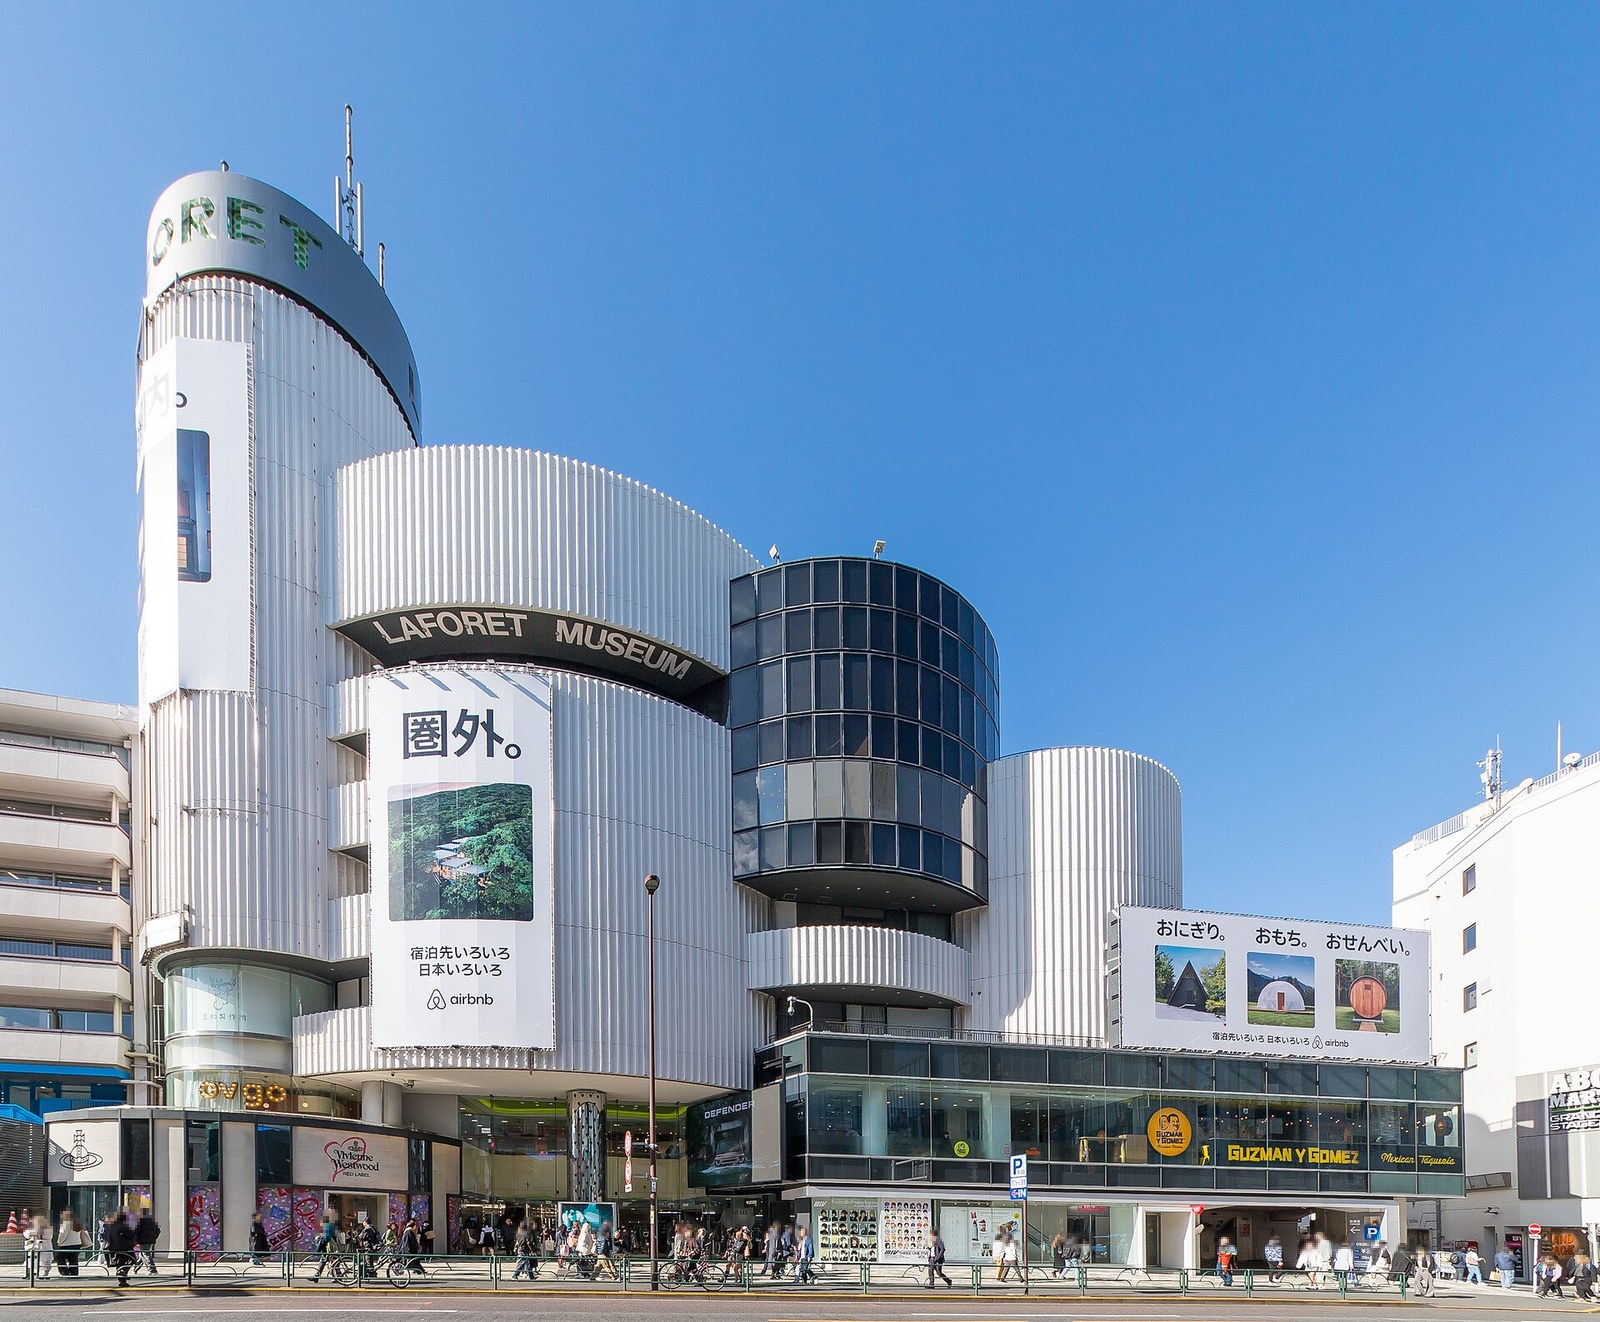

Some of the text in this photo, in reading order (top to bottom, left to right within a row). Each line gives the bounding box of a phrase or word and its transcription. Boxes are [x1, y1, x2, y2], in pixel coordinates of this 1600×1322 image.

[372, 611, 693, 680] LAFORET MUSEUM
[402, 708, 522, 760] 圏外。
[1156, 919, 1226, 942] おにぎり。
[1255, 927, 1308, 948] おもち。
[410, 946, 511, 961] 宿泊先いろいろ
[1326, 933, 1411, 957] おせんべい。
[419, 963, 502, 977] 日本いろいろ
[450, 993, 494, 1006] airbnb
[1212, 1031, 1349, 1048] 宿泊先いろいろ 日本いろいろ airbnb
[198, 1080, 287, 1107] ovgo
[704, 1100, 756, 1119] DEFENDER
[333, 1149, 374, 1161] Vivienne
[1227, 1144, 1359, 1164] GUZMAN Y GOMEZ
[1380, 1152, 1456, 1166] Mexican Taqueria
[330, 1158, 379, 1173] Westwood
[1013, 1158, 1023, 1175] P
[1367, 1228, 1378, 1239] P
